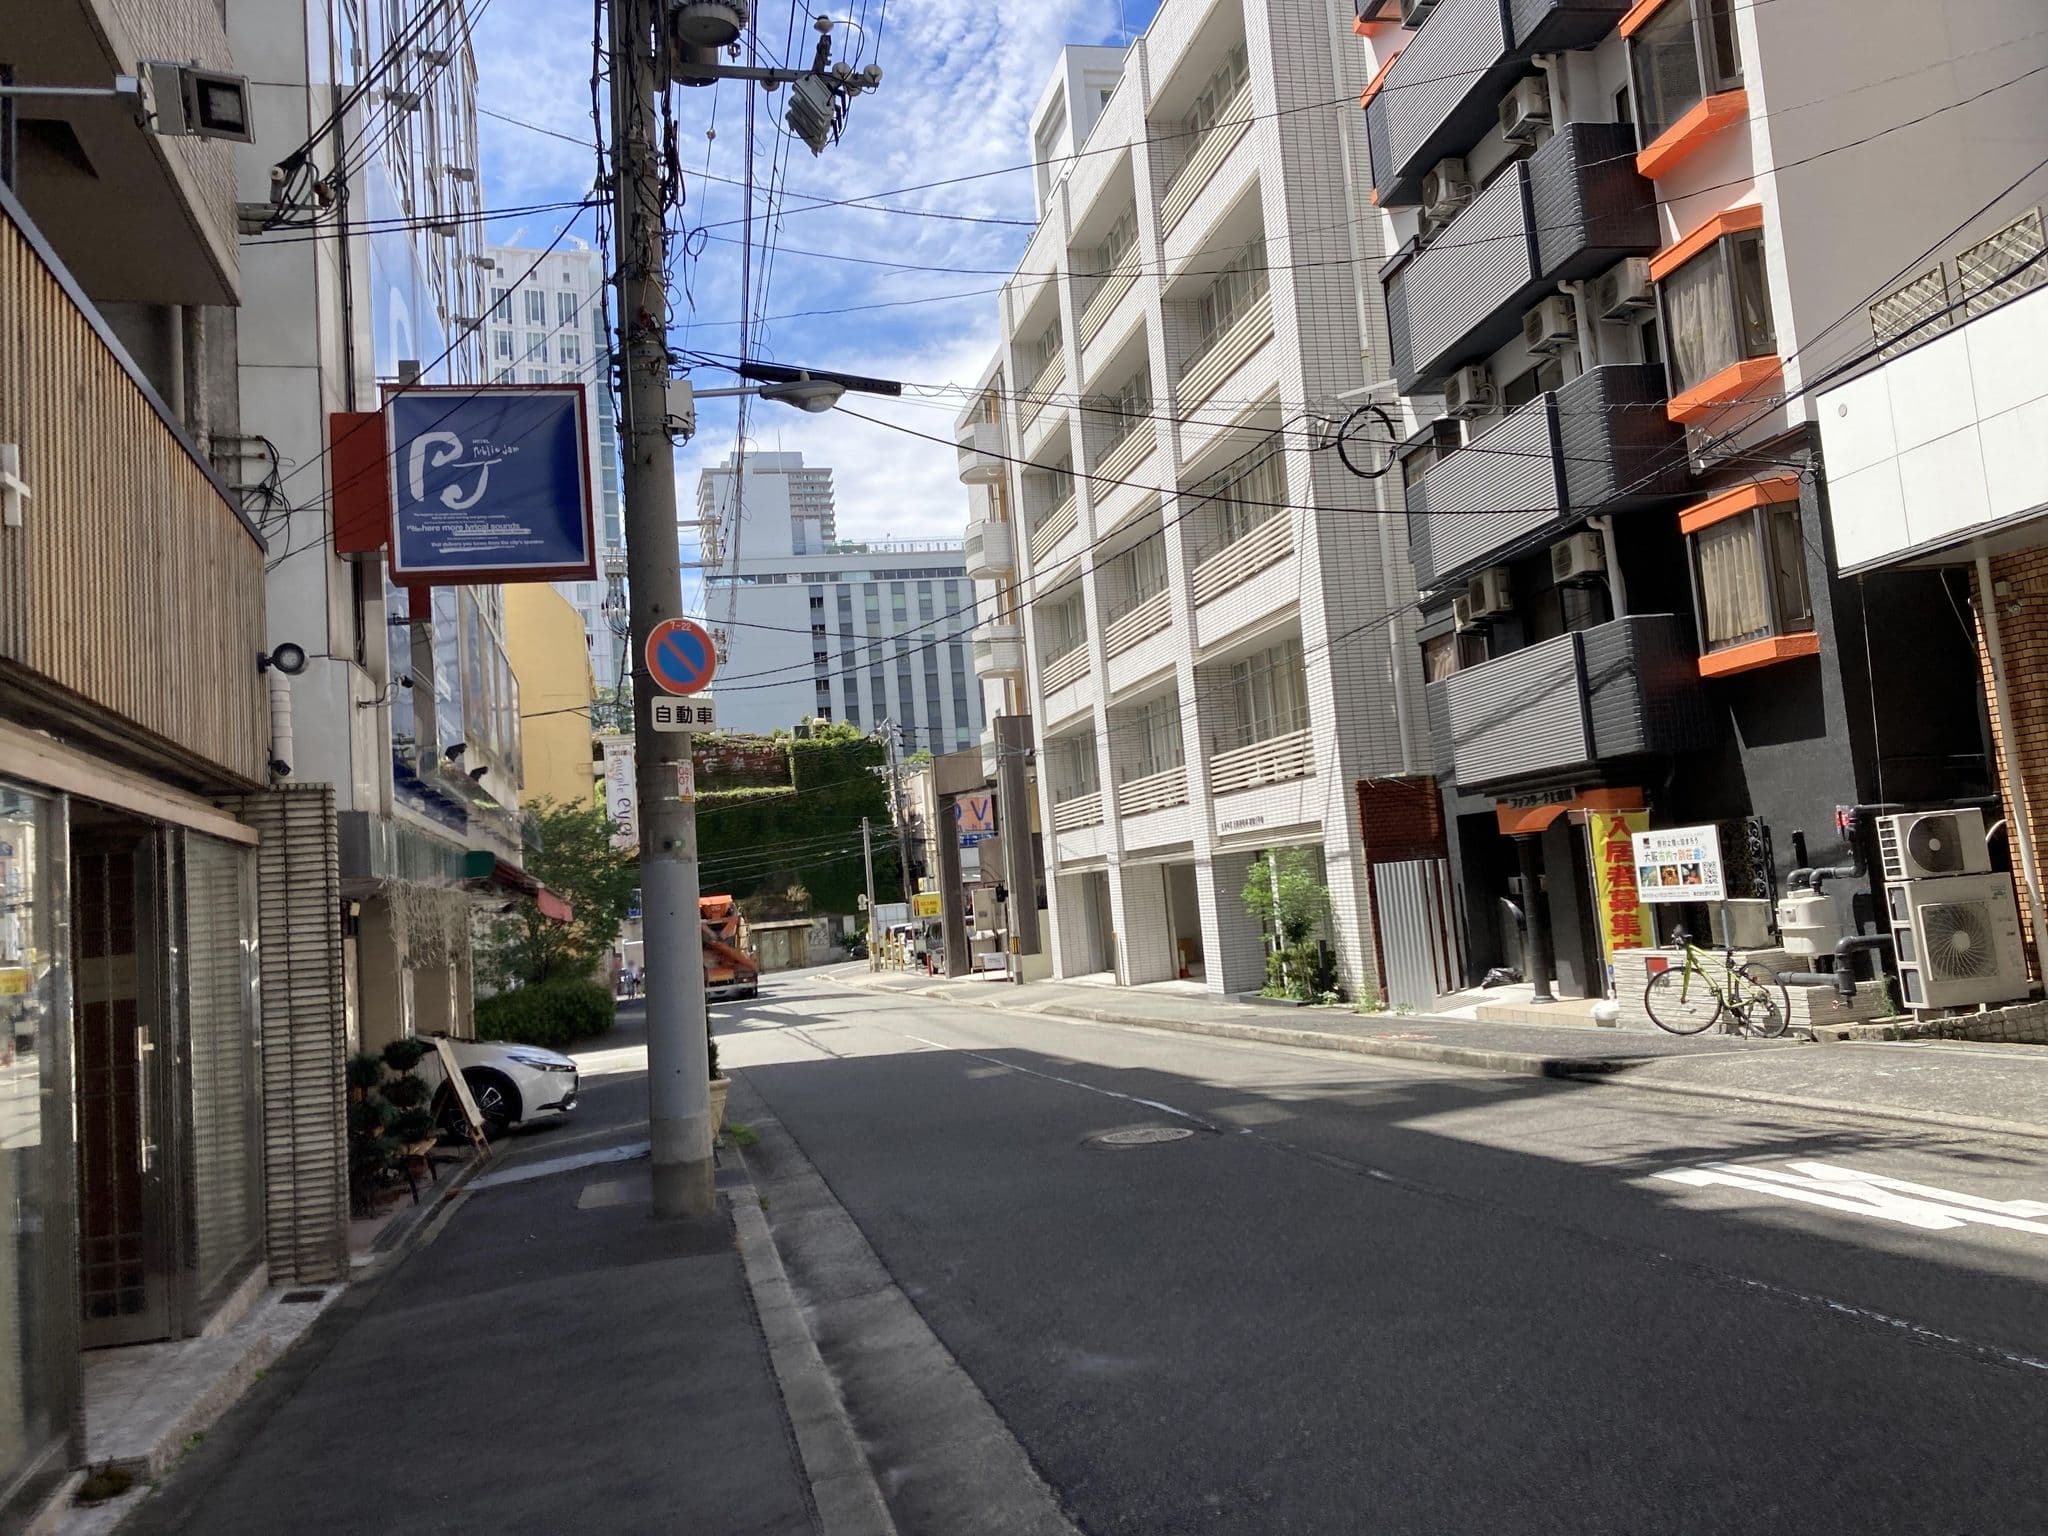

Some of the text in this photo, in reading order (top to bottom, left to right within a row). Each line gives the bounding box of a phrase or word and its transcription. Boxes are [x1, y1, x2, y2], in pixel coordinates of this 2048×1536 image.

[670, 621, 692, 632] 7-22
[656, 705, 713, 724] 自動車
